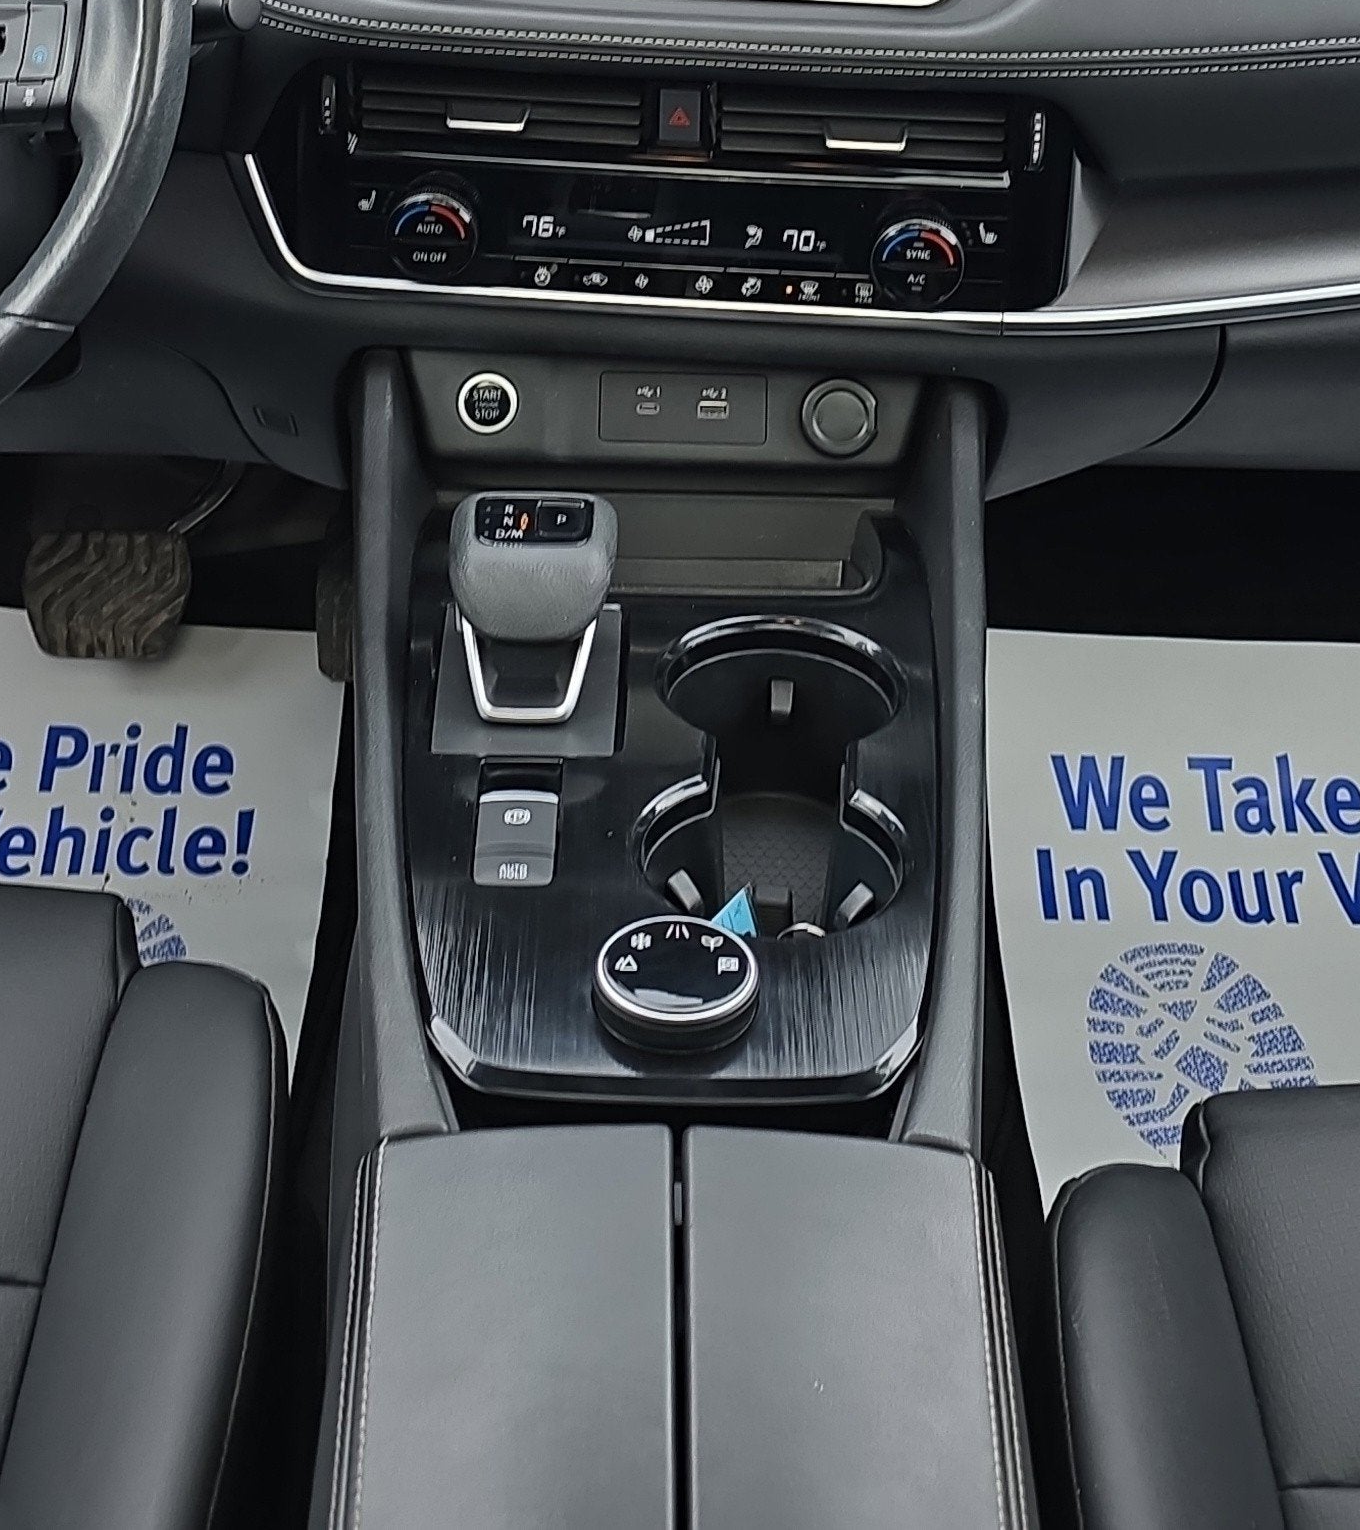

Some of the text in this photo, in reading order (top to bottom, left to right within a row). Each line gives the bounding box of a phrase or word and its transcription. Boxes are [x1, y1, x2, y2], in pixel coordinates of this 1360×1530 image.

[415, 223, 443, 235] AUTO
[412, 250, 448, 263] ON OFF
[905, 248, 931, 261] SYNC
[906, 273, 927, 286] A/C
[472, 387, 502, 401] START
[474, 408, 500, 421] STOP
[503, 515, 514, 527] N
[555, 513, 568, 525] P
[39, 722, 235, 795] Pride
[1049, 752, 1171, 833] We
[1036, 848, 1112, 922] In
[1125, 849, 1304, 925] Your
